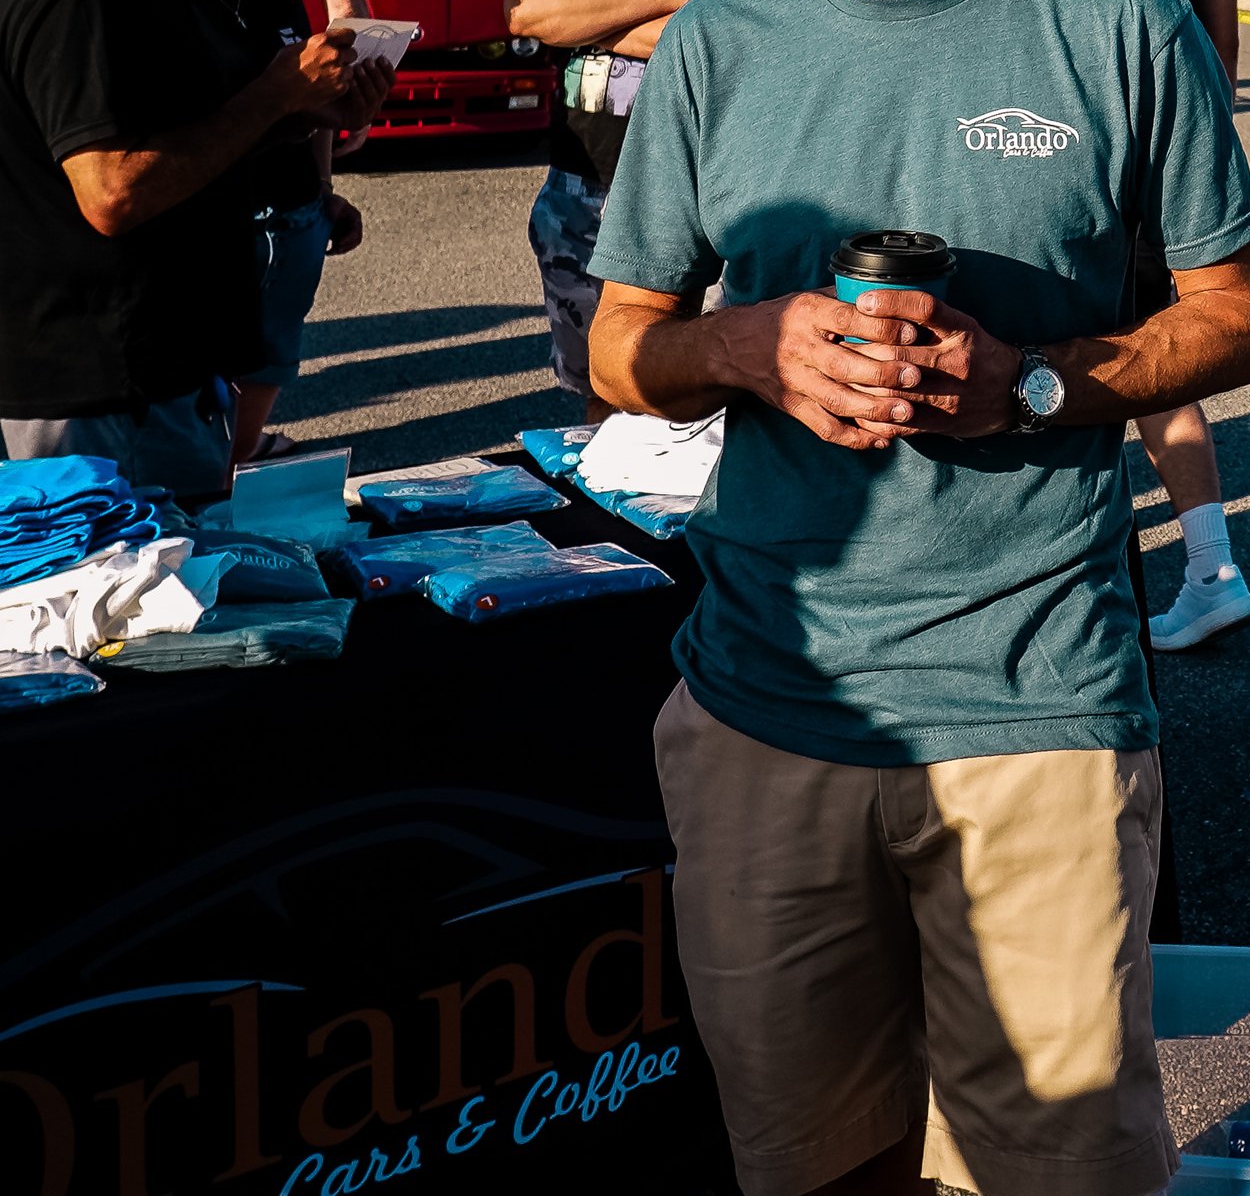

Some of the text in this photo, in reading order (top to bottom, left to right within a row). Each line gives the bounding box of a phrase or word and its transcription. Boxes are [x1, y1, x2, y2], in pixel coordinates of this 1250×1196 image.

[965, 126, 1069, 151] Orlando
[237, 551, 290, 570] lando
[0, 868, 680, 1196] rland
[278, 1041, 681, 1196] Cars & Coffee
